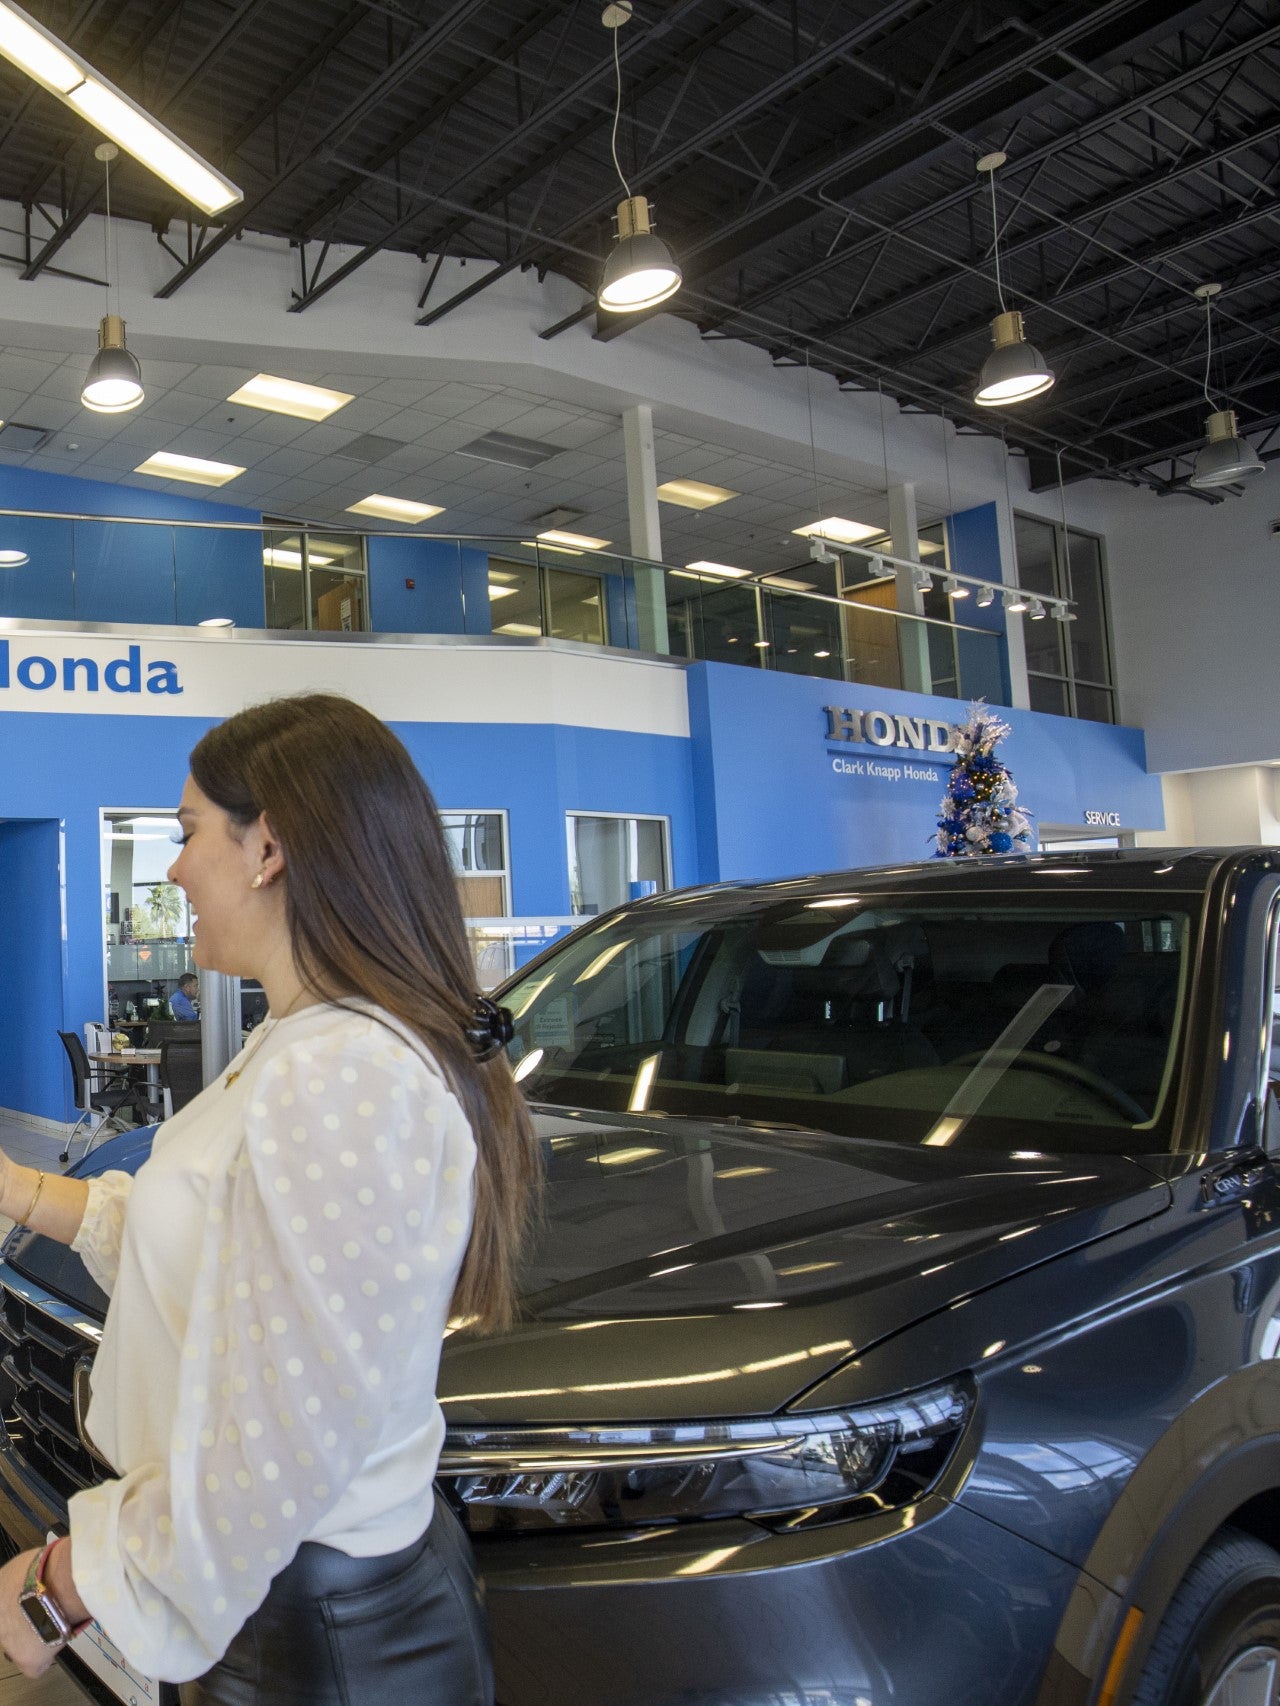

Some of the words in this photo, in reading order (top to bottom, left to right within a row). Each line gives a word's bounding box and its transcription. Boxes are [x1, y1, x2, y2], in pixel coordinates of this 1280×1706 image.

[825, 706, 964, 754] HOND
[832, 758, 864, 775] Clark
[867, 762, 901, 782] Knapp
[904, 766, 938, 782] Honda
[1085, 811, 1120, 826] SERVICE
